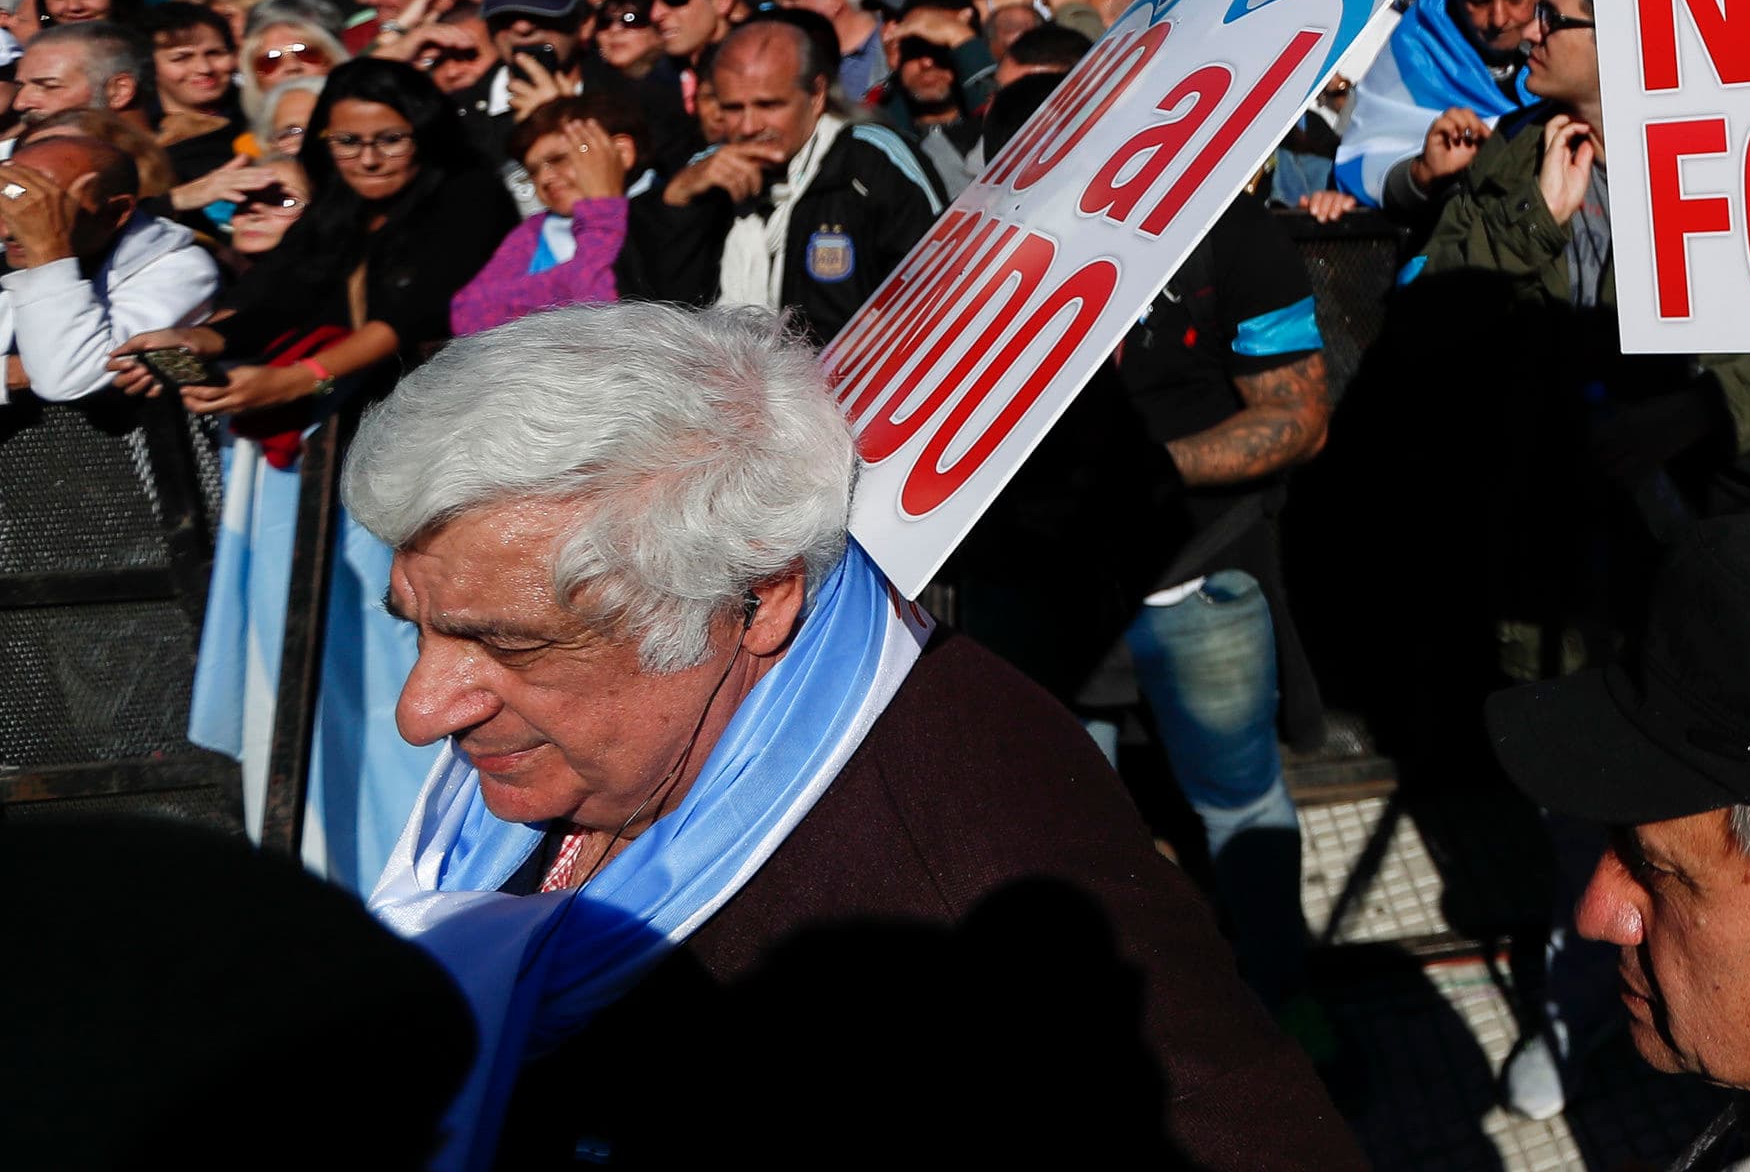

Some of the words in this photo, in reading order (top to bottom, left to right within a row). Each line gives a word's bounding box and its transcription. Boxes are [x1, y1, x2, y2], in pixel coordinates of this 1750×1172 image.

[980, 21, 1172, 192] NO
[1080, 30, 1325, 237] al
[823, 210, 1119, 517] FONDO
